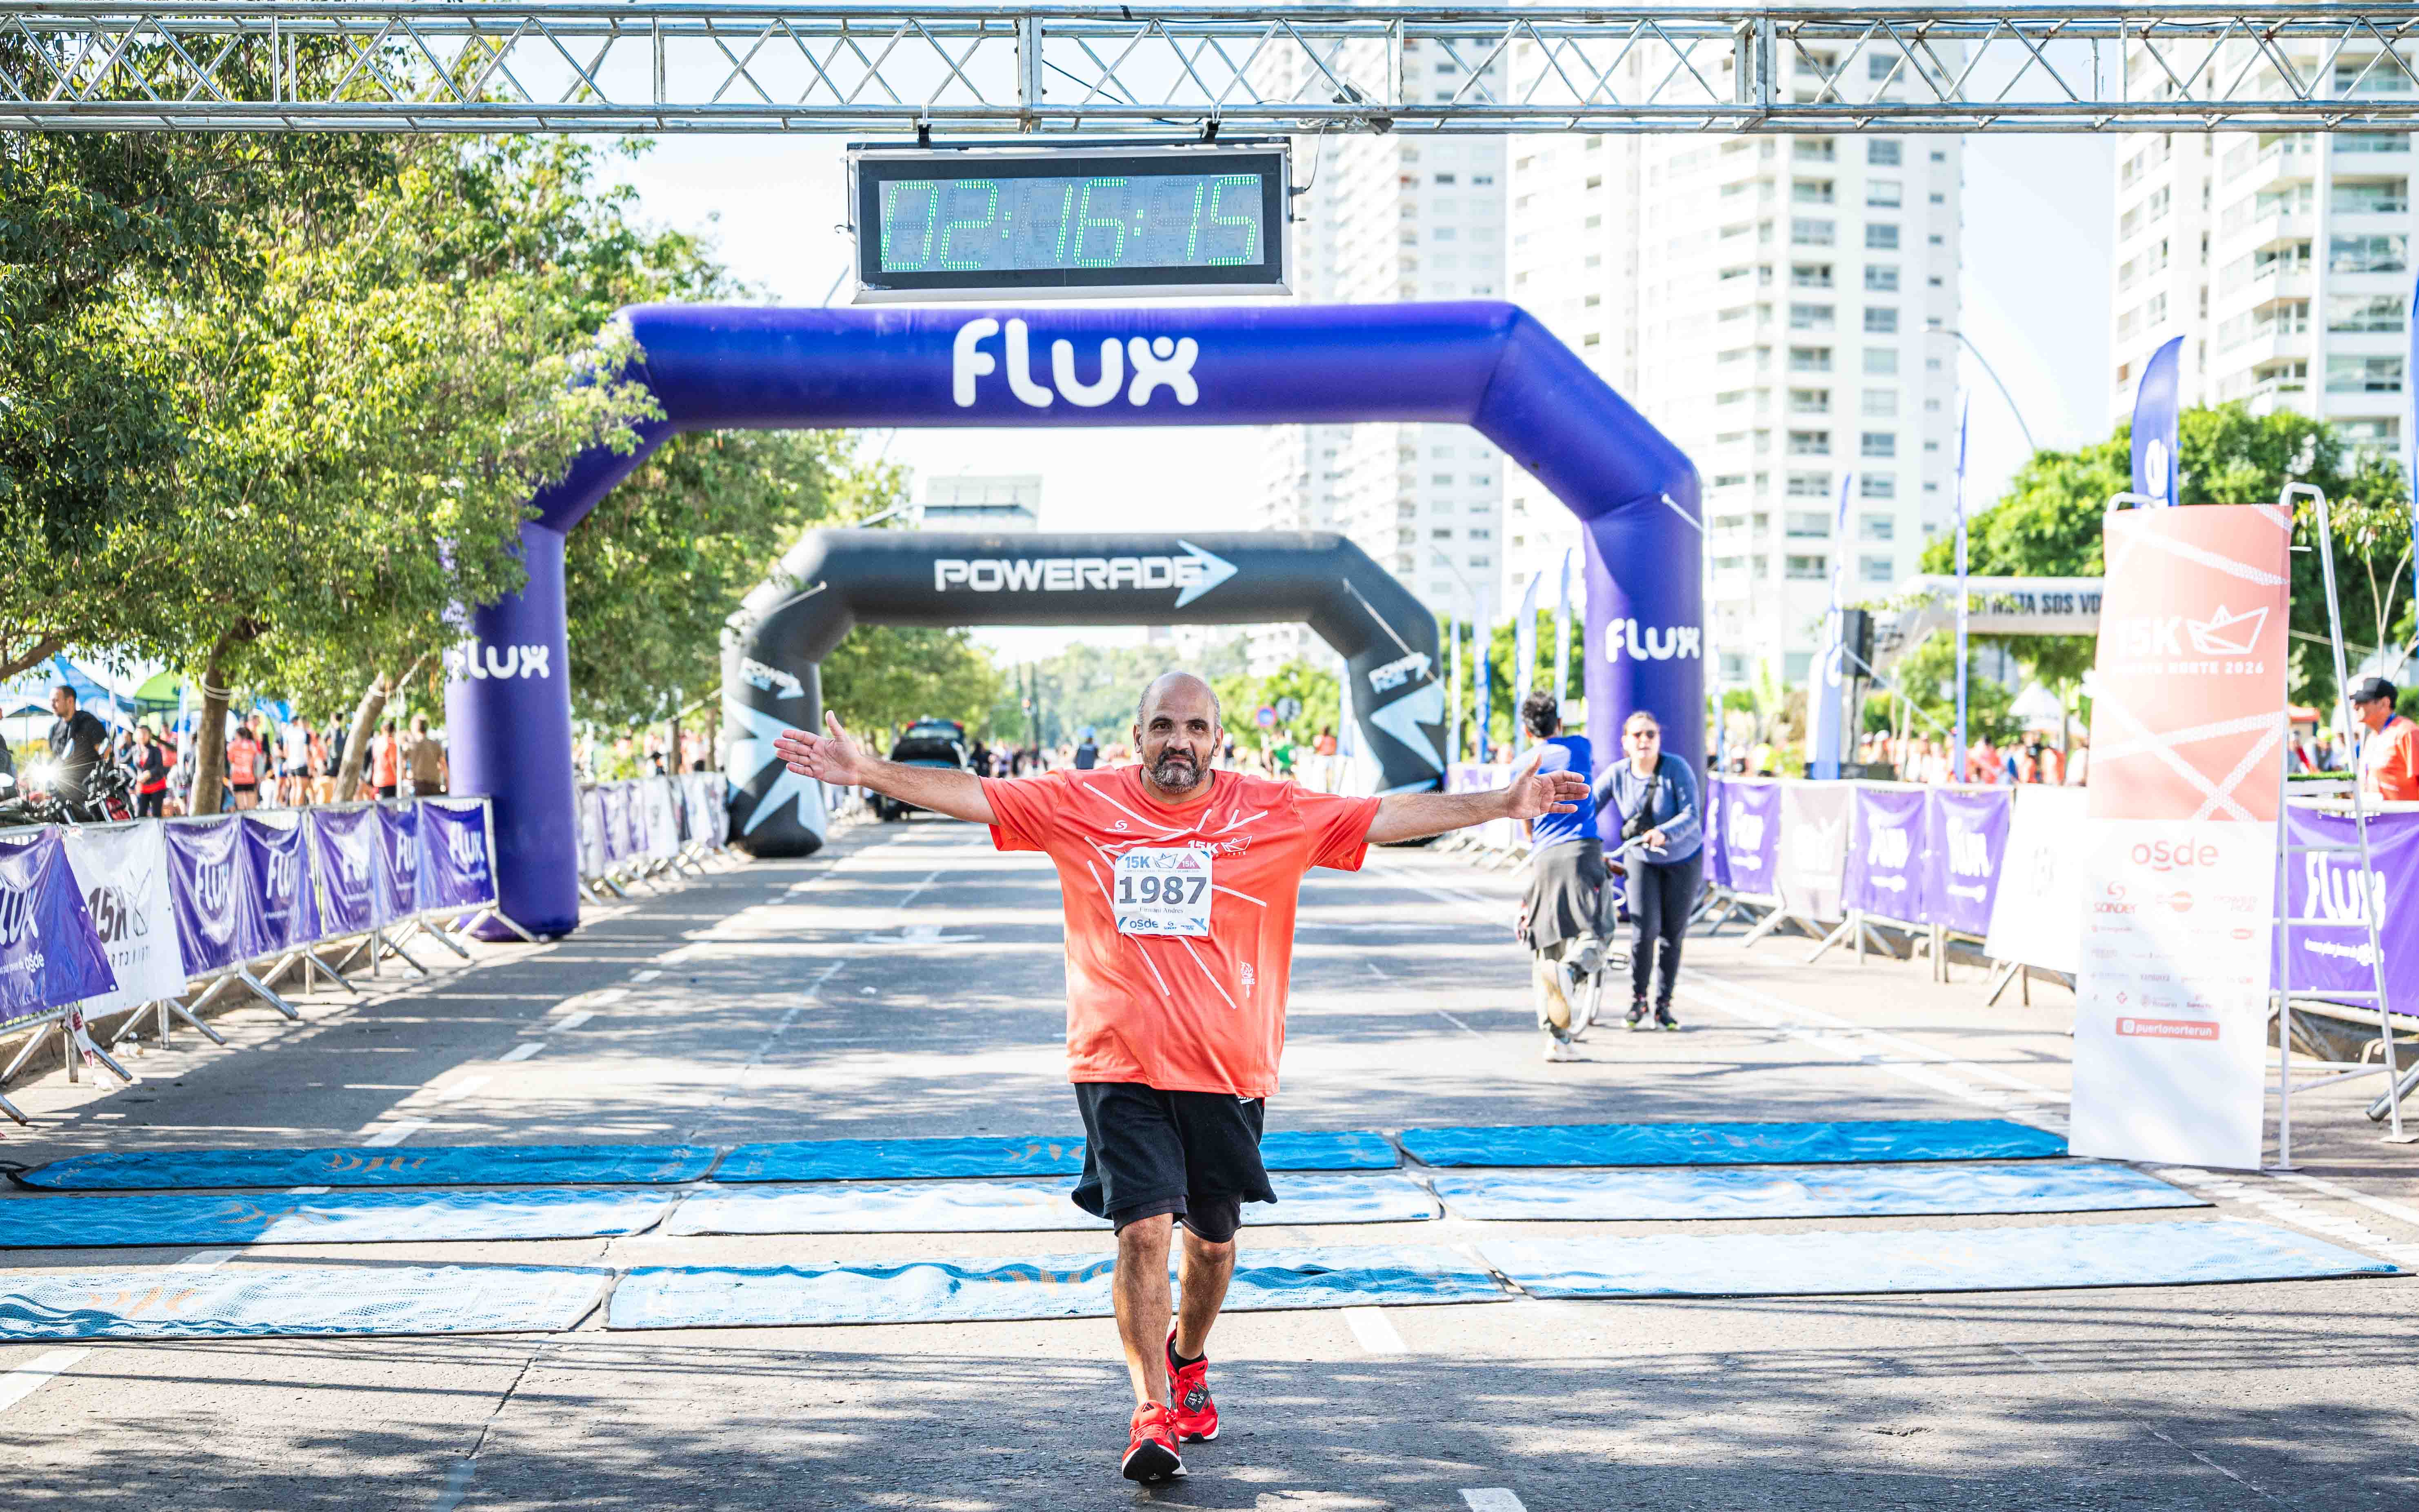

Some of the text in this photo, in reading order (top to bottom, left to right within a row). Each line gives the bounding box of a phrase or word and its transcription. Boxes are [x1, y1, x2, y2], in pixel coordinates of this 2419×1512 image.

[881, 175, 1259, 271] 02:16:15
[934, 556, 1206, 591] POWERADE
[1125, 855, 1150, 868] 15K
[2131, 836, 2219, 872] osde
[1119, 876, 1207, 904] 1987
[1130, 918, 1159, 930] osde
[2136, 1023, 2213, 1037] puertonorterun
